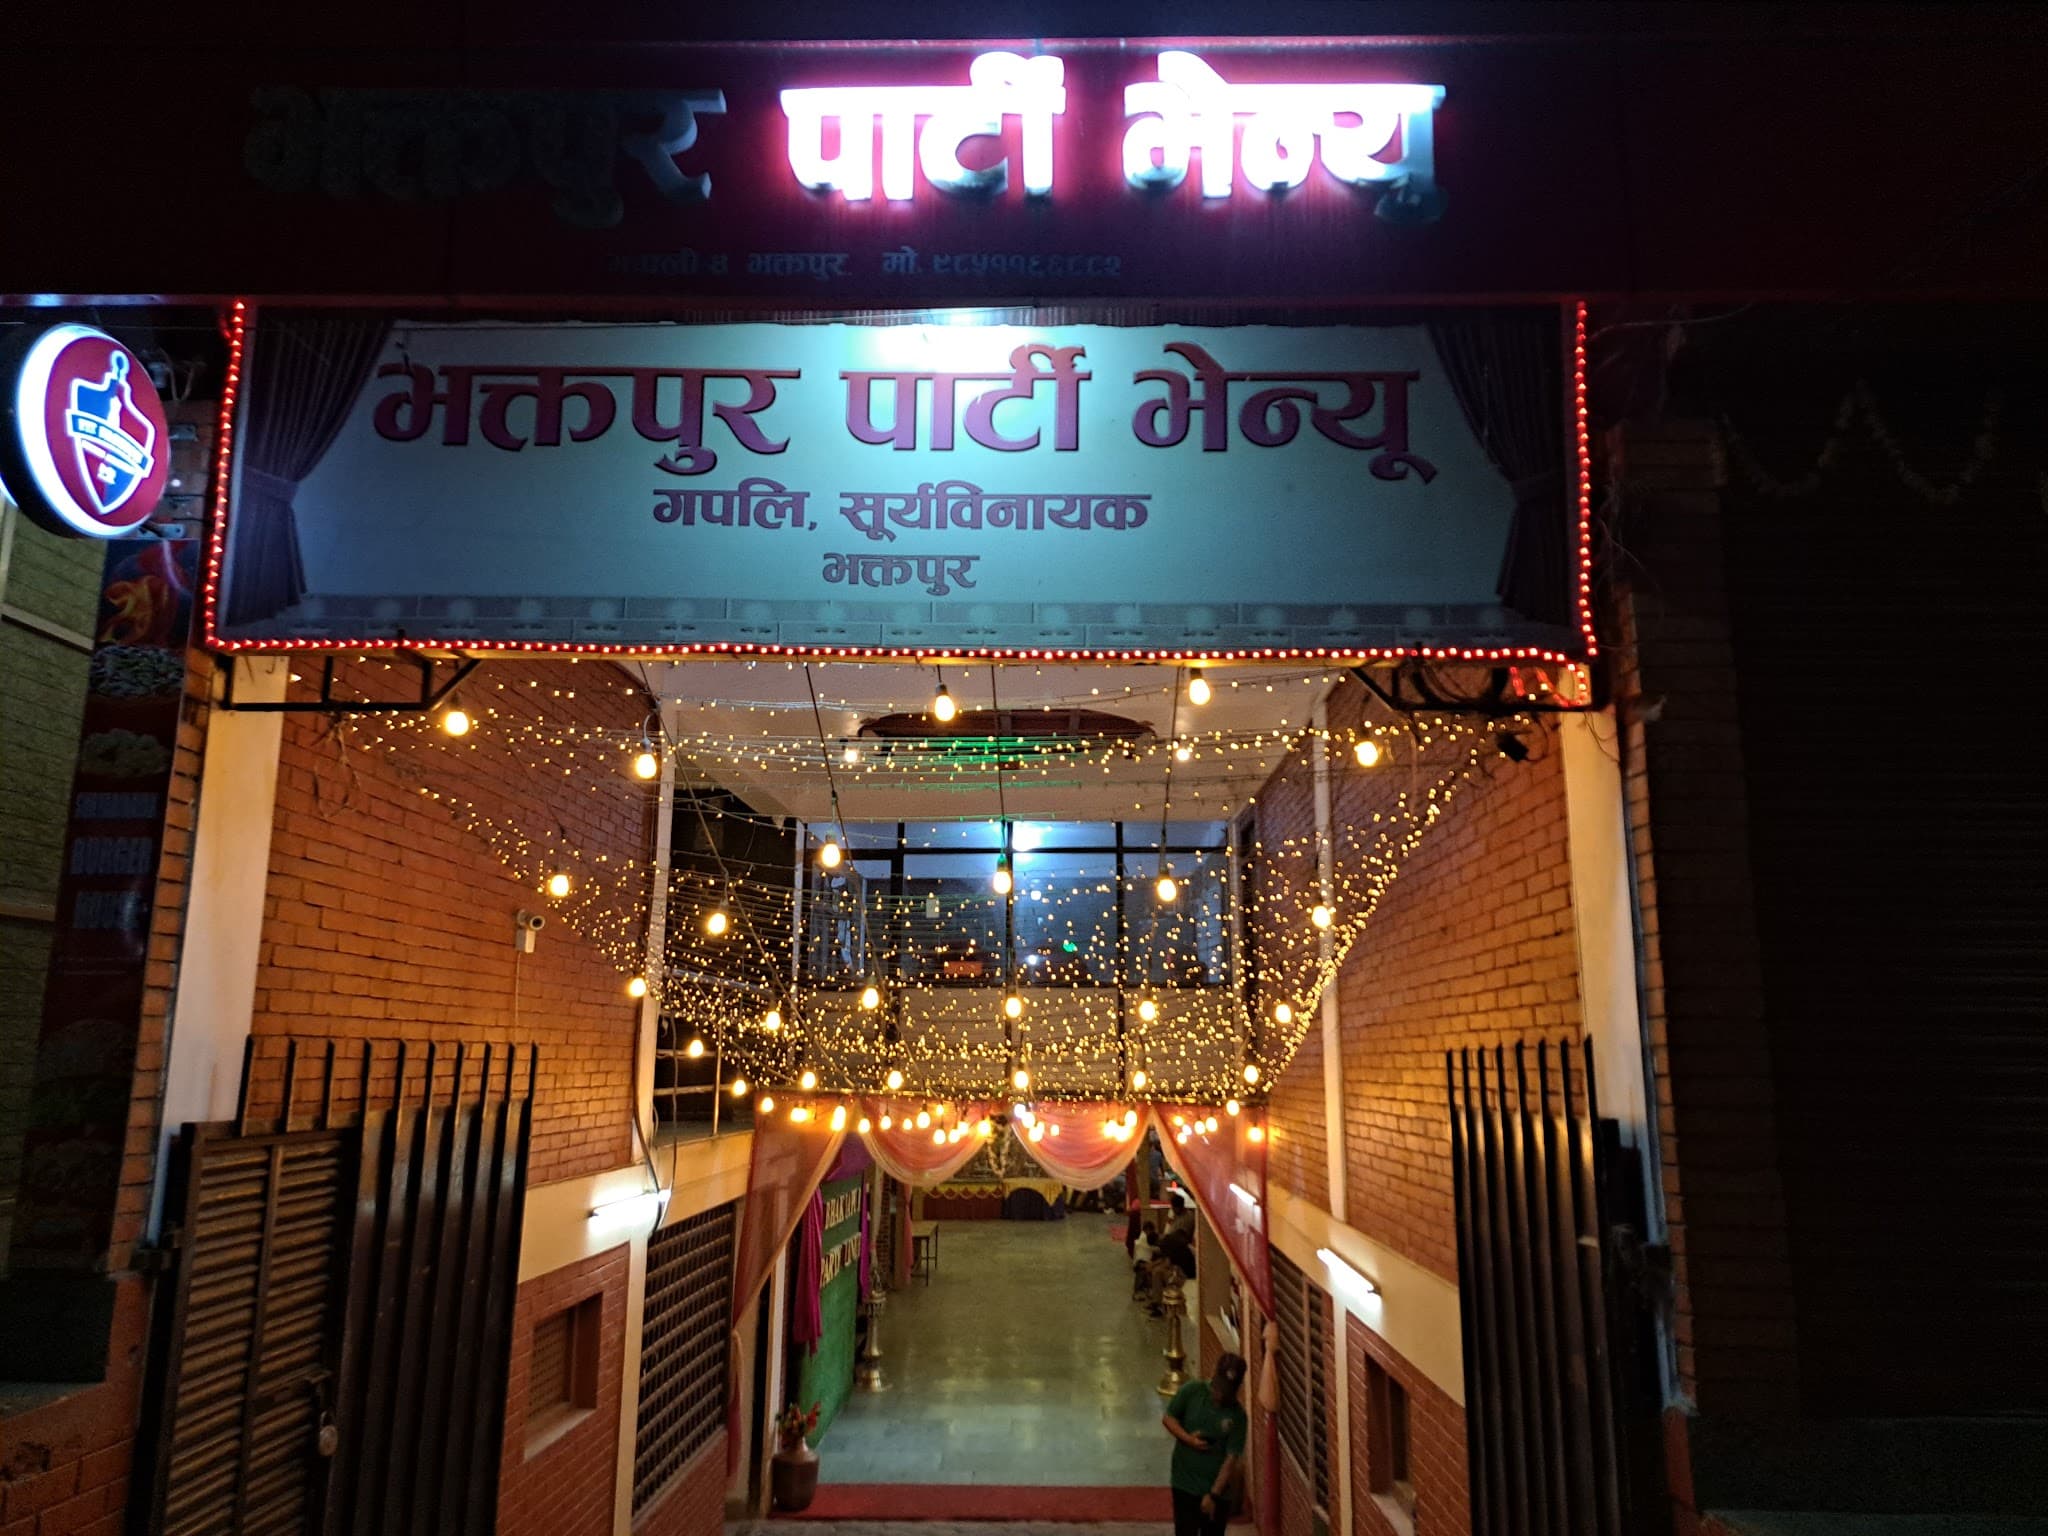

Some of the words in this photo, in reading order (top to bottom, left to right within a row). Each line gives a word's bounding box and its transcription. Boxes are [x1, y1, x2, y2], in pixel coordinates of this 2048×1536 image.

[780, 52, 1067, 201] पार्टी
[373, 362, 801, 476] भक्तपुर
[838, 343, 1092, 452] पार्टी
[1132, 341, 1438, 484] भेन्यू
[840, 480, 1153, 543] सूर्यविनायक
[822, 553, 981, 596] भक्तपुर
